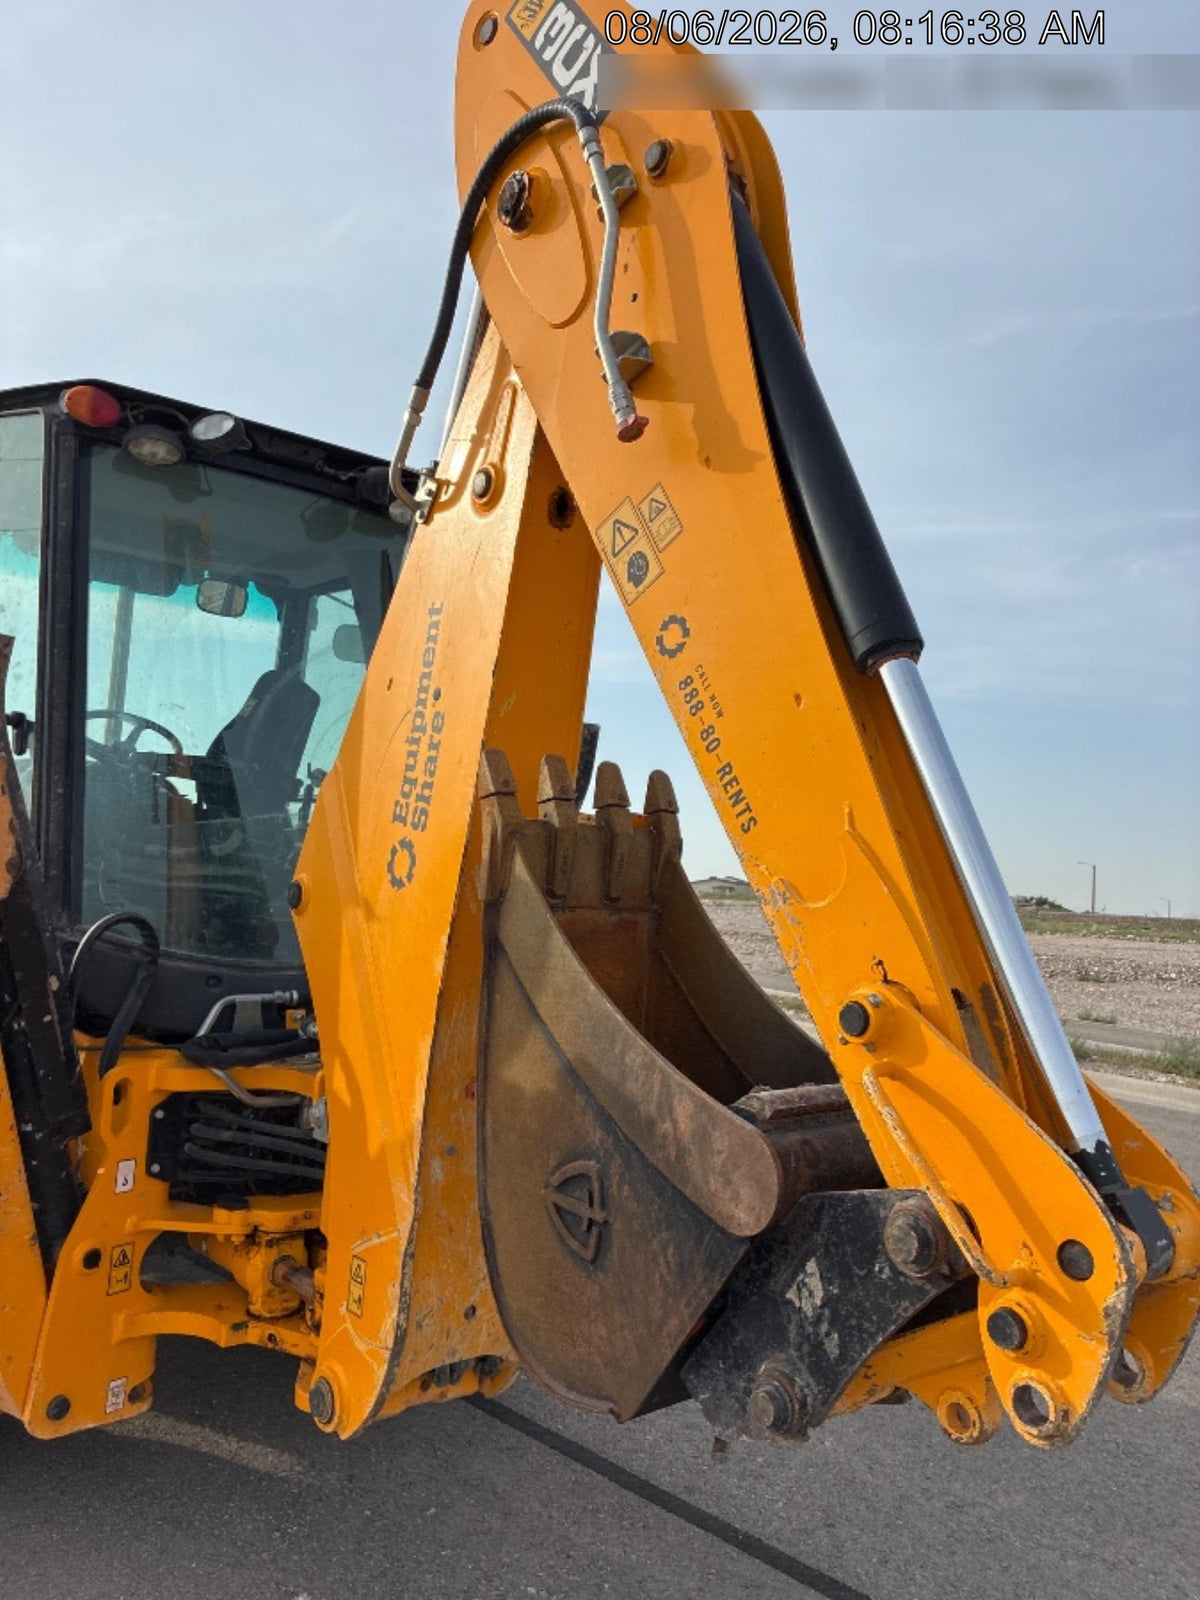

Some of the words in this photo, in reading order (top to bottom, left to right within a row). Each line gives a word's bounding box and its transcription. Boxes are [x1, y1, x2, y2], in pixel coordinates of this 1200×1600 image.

[392, 602, 444, 827] Equipment
[678, 675, 758, 834] 888-80-RENTS
[695, 664, 712, 691] CALL
[709, 694, 724, 719] NOW
[410, 710, 445, 833] Share
